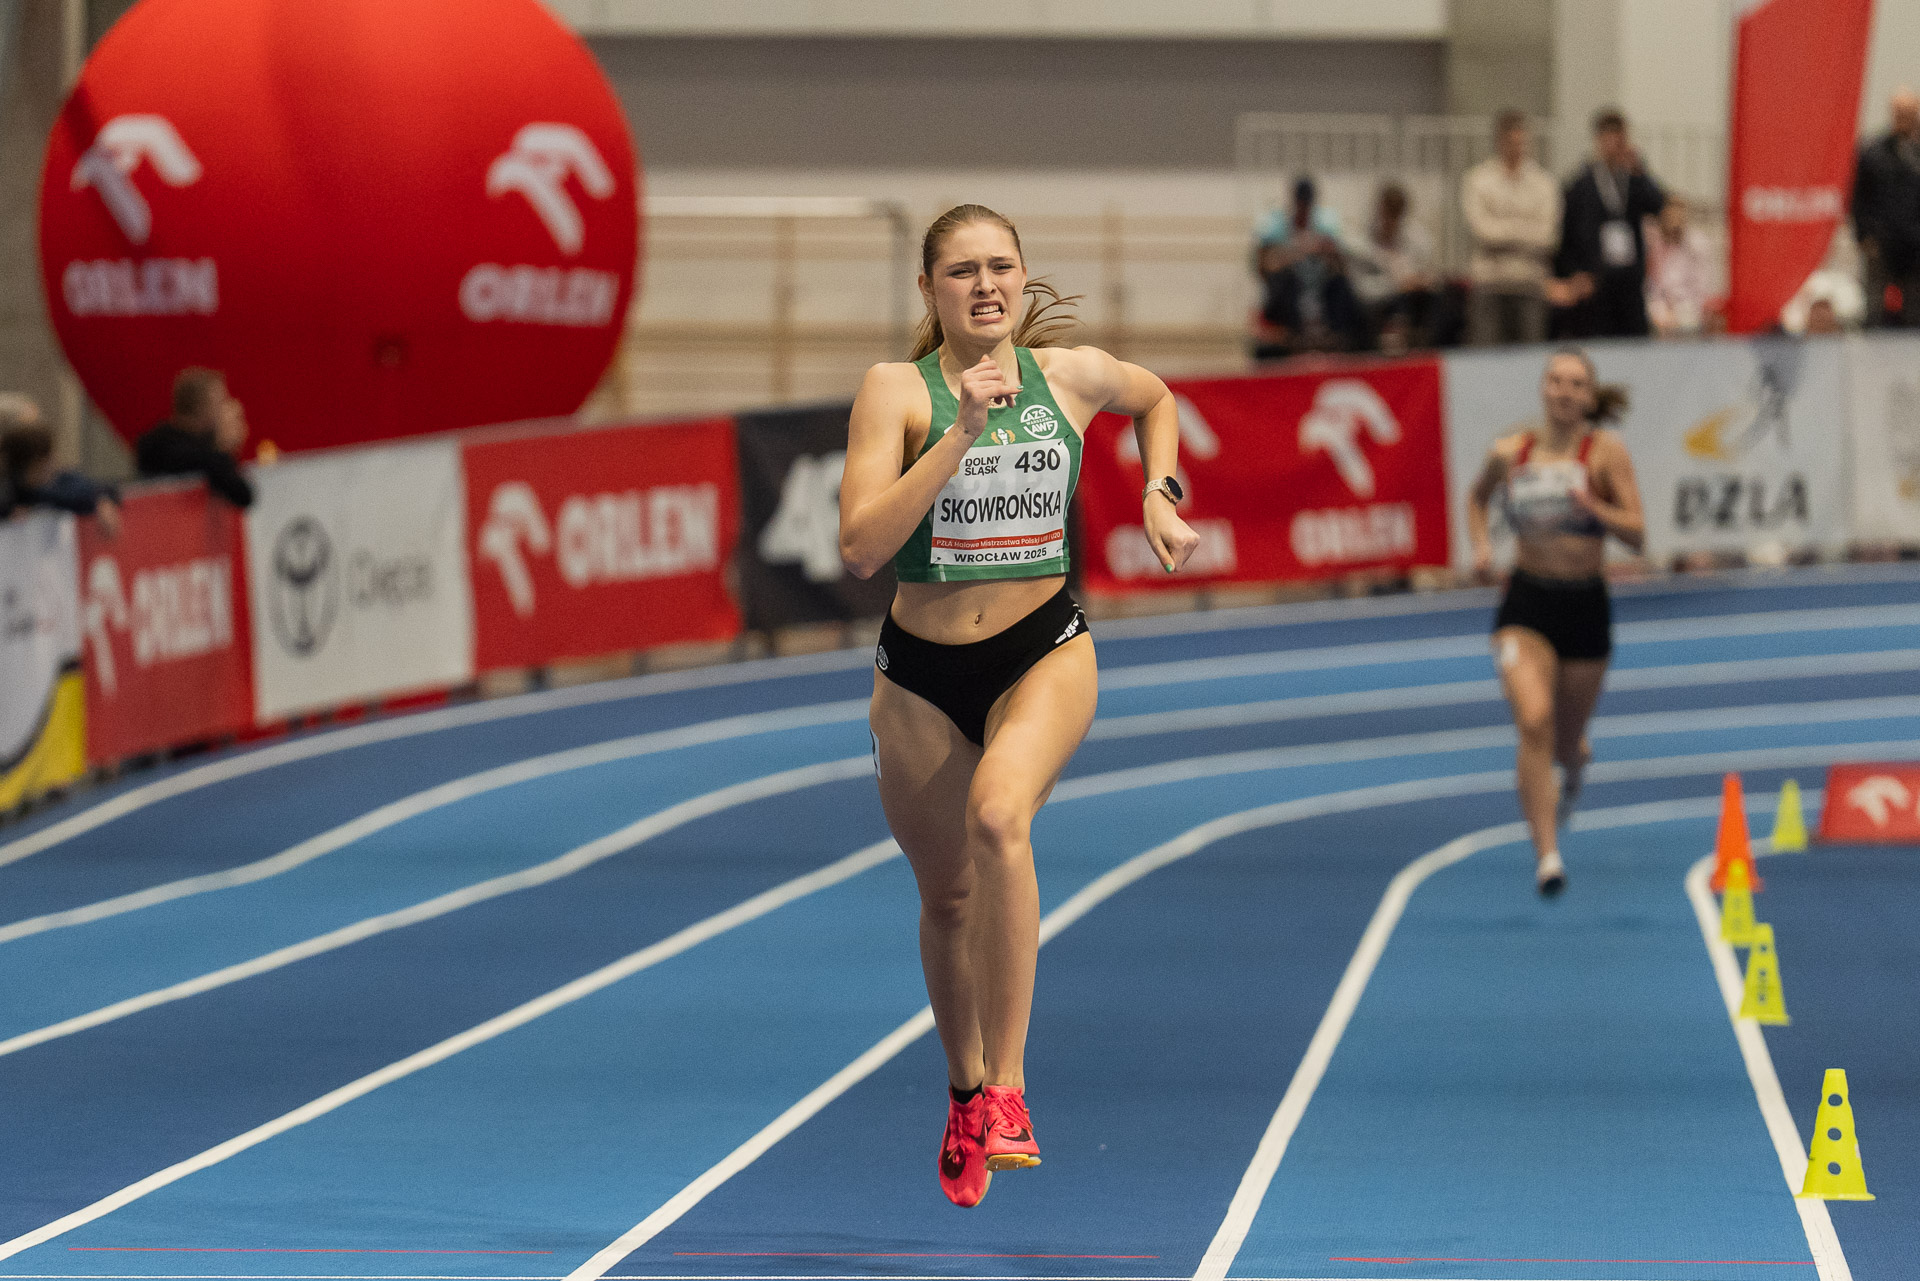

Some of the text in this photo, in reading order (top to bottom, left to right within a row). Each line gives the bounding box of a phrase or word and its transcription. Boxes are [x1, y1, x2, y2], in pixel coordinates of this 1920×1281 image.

[1026, 409, 1047, 420] AZS
[1031, 422, 1053, 433] AWF
[965, 455, 1001, 467] DOLNY
[1014, 448, 1061, 474] 430
[964, 464, 999, 477] ŚLĄSK
[940, 488, 1061, 525] SKOWROŃSKA
[556, 481, 719, 590] ORLEN
[980, 538, 1020, 547] Mistrzostwa
[1021, 537, 1040, 545] Polski
[954, 547, 1047, 563] WROCŁAW 2025
